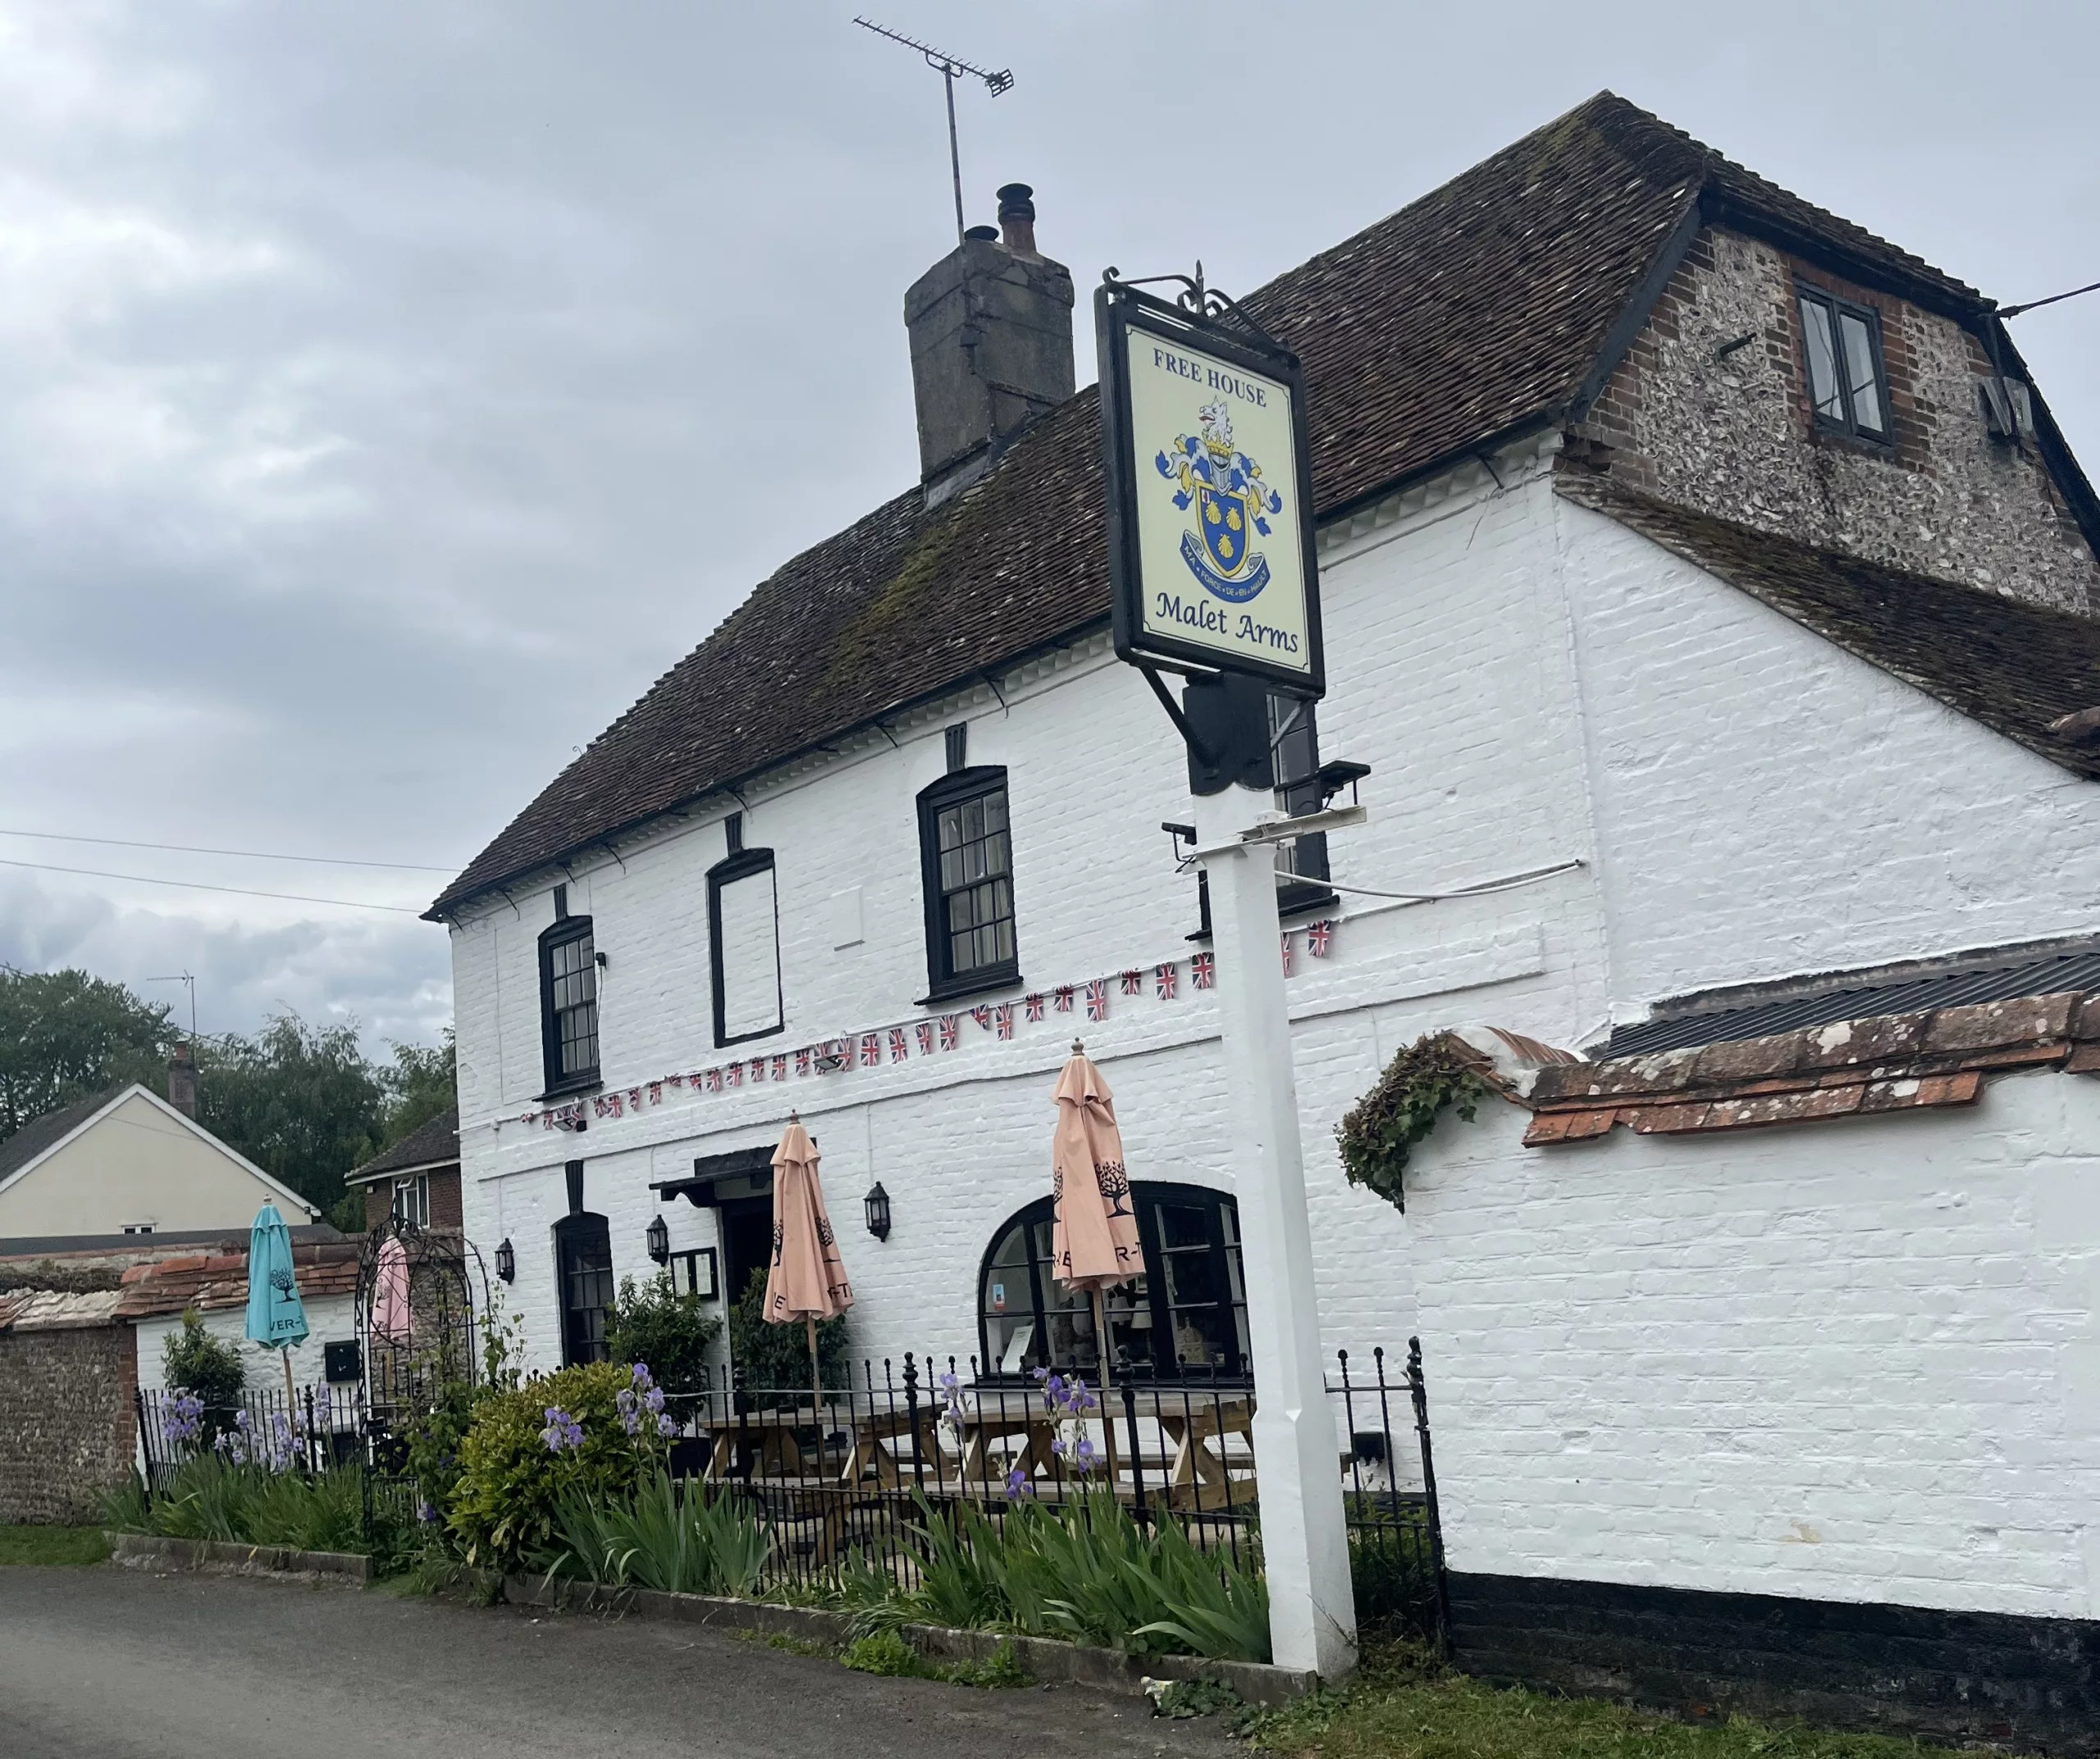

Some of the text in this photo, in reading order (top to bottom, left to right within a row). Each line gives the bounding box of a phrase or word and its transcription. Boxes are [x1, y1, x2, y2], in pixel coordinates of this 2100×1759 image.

[1153, 348, 1267, 408] FREE HOUSE
[1185, 546, 1196, 566] MA
[1201, 569, 1221, 592] FORCE
[1226, 587, 1235, 596] DE
[1156, 592, 1299, 653] Malet Arms
